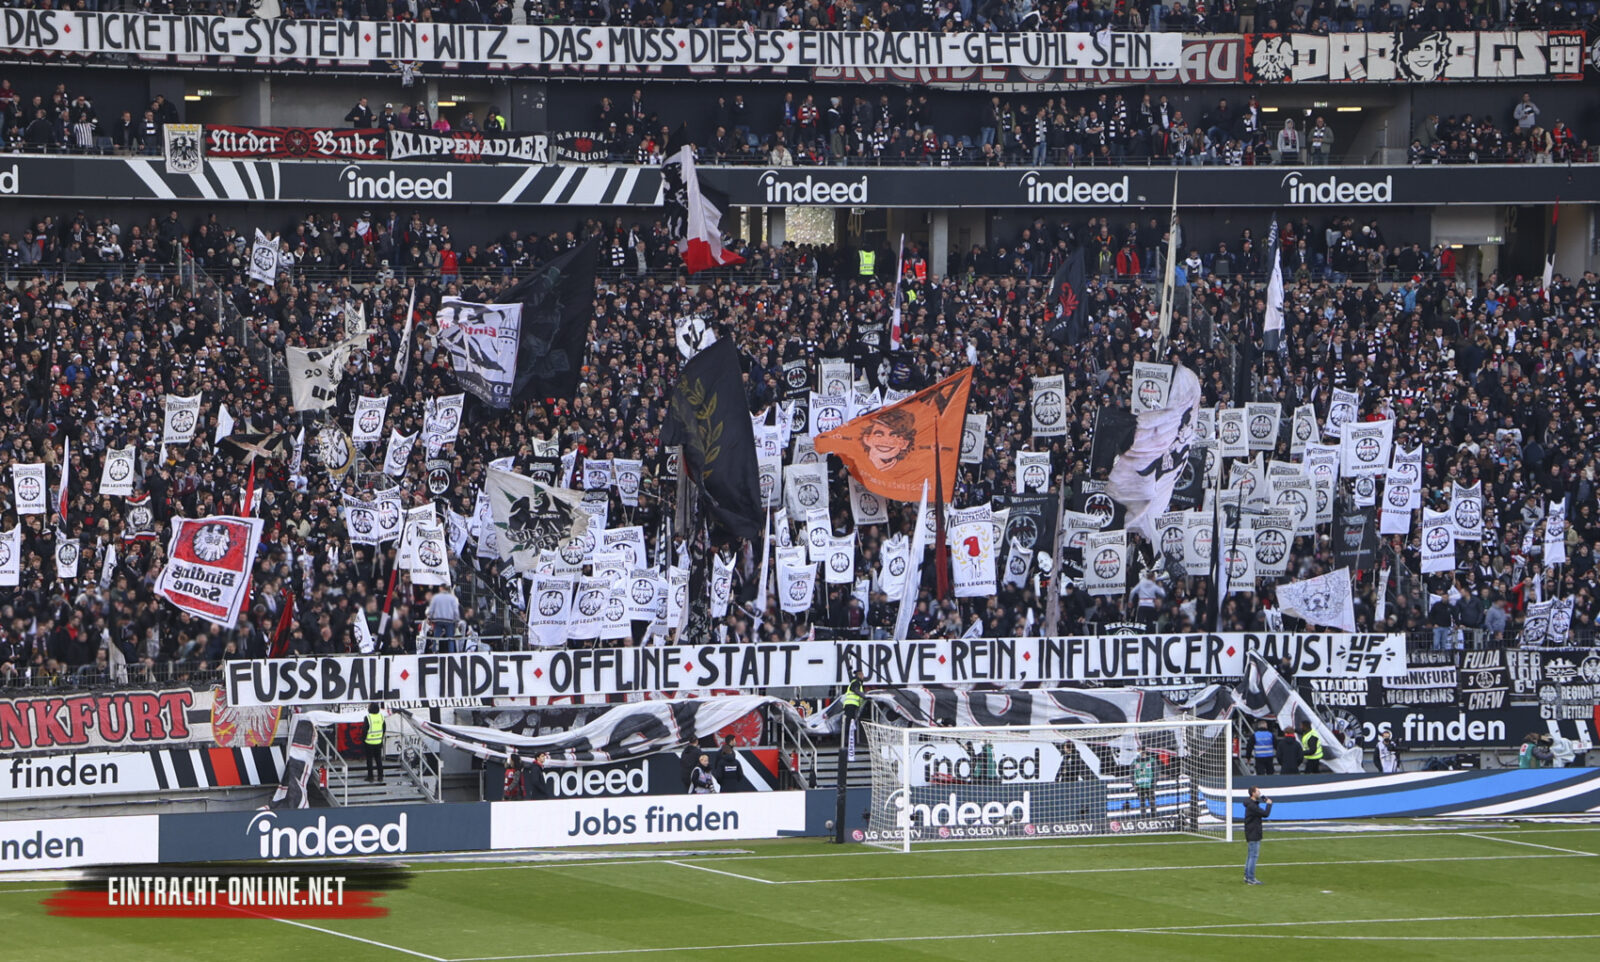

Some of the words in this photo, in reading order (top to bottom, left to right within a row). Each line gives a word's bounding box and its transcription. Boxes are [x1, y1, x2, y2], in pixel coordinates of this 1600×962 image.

[5, 9, 59, 47] DAS
[75, 12, 360, 58] TICKETING-SYSTEM
[376, 22, 418, 60] EIN
[433, 24, 508, 61] WITZ
[540, 26, 593, 62] DAS
[609, 27, 675, 63] MUSS
[688, 28, 785, 63] DIESES
[800, 29, 1077, 67] EINTRACHT-GEFÜHL
[1091, 33, 1174, 68] SEIN...
[1550, 47, 1580, 74] 99
[211, 129, 281, 153] Nieder
[313, 130, 380, 155] Bube
[389, 130, 548, 163] KLIPPENADLER
[346, 168, 453, 199] indeed
[764, 172, 869, 204] indeed
[1026, 173, 1129, 204] indeed
[1288, 173, 1392, 204] indeed
[229, 655, 400, 706] FUSSBALL
[418, 655, 532, 698] FINDET
[549, 647, 681, 693] OFFLINE
[697, 644, 800, 687] STATT
[835, 640, 938, 684] KURVE
[951, 639, 1027, 681] REIN,
[1037, 633, 1224, 679] INFLUENCER
[1463, 650, 1501, 669] FULDA
[1310, 679, 1369, 691] STADION
[1311, 692, 1368, 706] VERBOT
[1387, 688, 1454, 705] HOOLIGANS
[1468, 691, 1506, 710] CREW
[1560, 685, 1593, 700] REGION
[0, 694, 194, 749] NKFURT
[1403, 713, 1506, 741] finden
[1540, 705, 1557, 719] 61
[10, 757, 119, 790] finden
[549, 759, 650, 797] ndeed
[922, 747, 1041, 783] inded
[567, 808, 637, 838] Jobs
[645, 804, 739, 833] finden
[894, 790, 1031, 828] indeed
[257, 812, 408, 858] indeed
[865, 830, 878, 840] LG
[908, 829, 922, 838] TV
[951, 828, 965, 837] LG
[967, 827, 992, 836] OLED
[994, 827, 1008, 836] TV
[1037, 825, 1050, 834] LG
[1053, 824, 1079, 833] OLED
[1079, 823, 1093, 832] TV
[1121, 822, 1135, 830] LG
[1163, 820, 1175, 828] TV
[0, 830, 84, 861] nden
